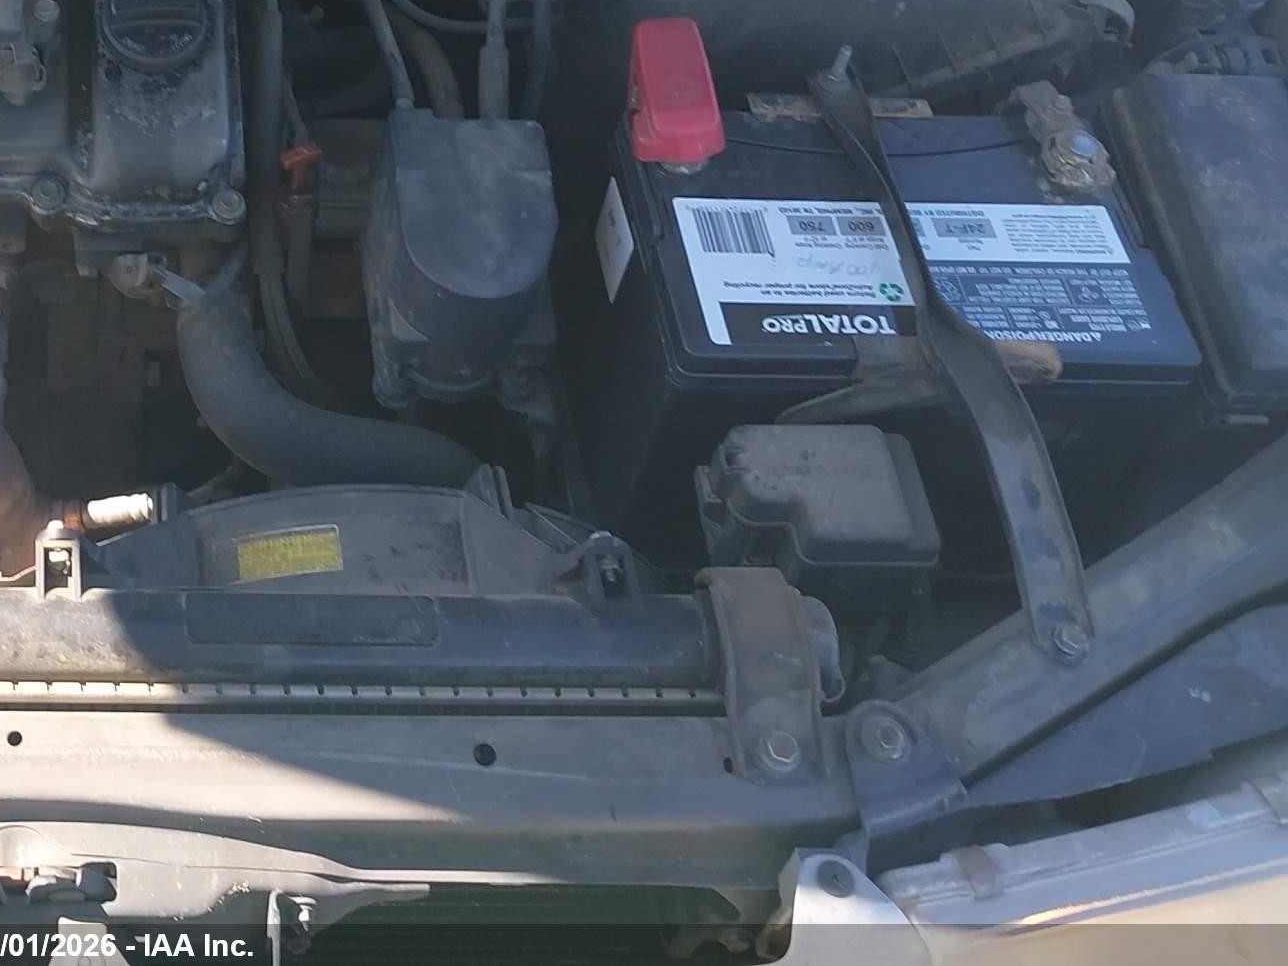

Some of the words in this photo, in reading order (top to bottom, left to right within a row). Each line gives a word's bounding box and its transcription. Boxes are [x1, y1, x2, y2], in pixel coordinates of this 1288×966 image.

[798, 220, 825, 232] 750
[847, 221, 874, 232] 600
[944, 223, 987, 235] 24F-T
[760, 313, 897, 335] TOTALPRO
